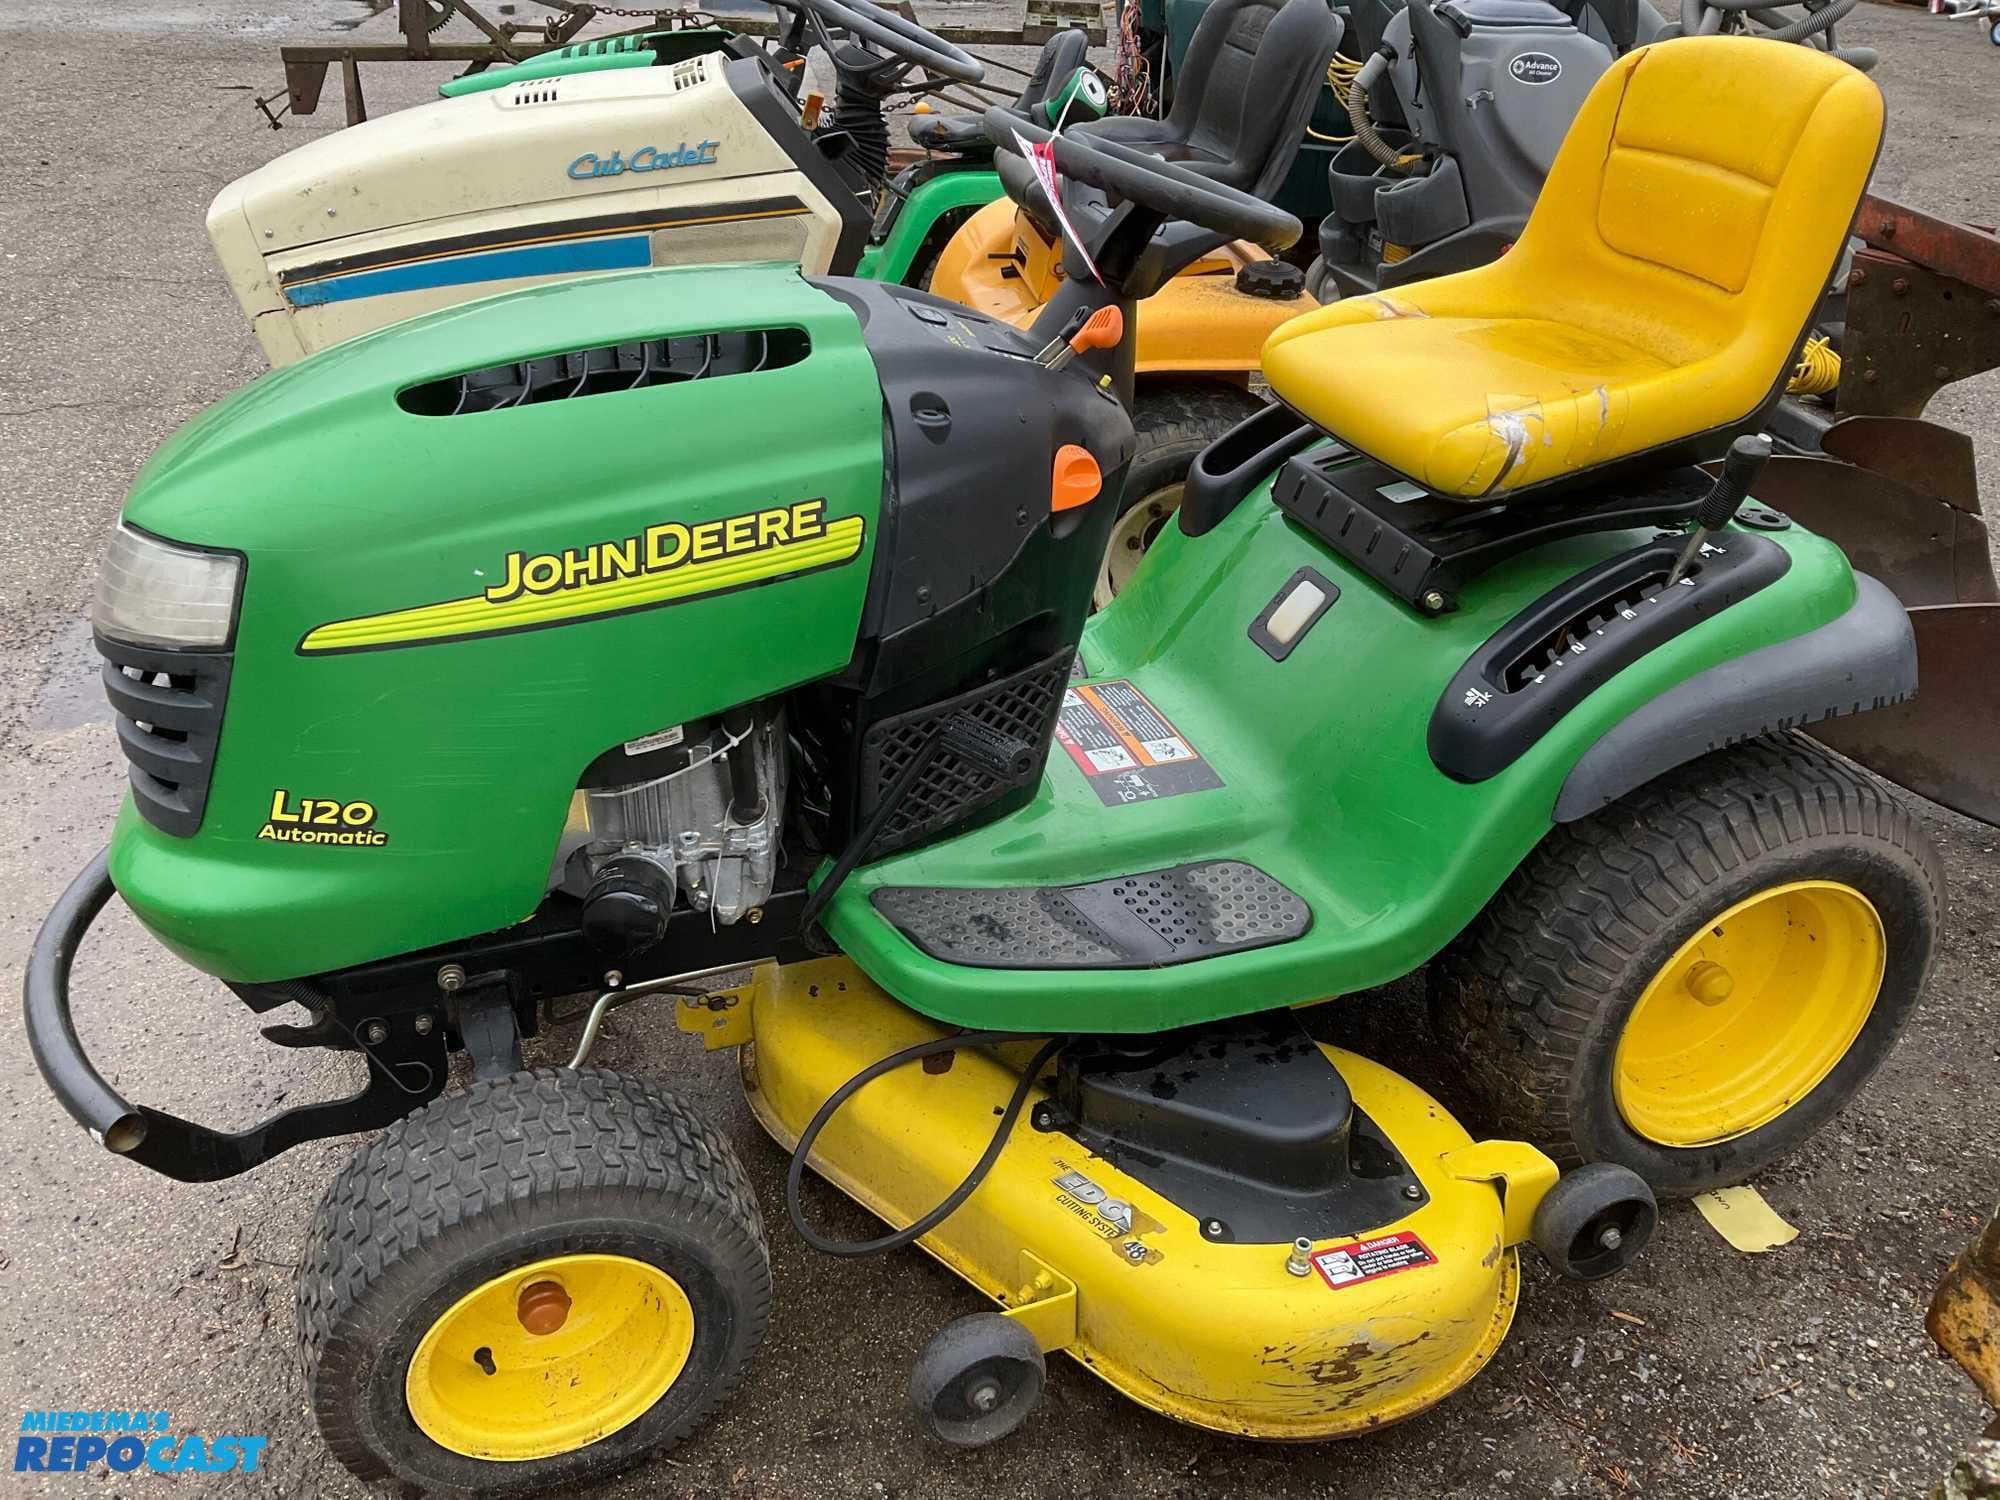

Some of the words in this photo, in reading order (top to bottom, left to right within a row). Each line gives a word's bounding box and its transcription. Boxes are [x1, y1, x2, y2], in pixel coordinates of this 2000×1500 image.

[1525, 61, 1558, 71] Advance
[568, 149, 626, 179] Cub
[628, 139, 721, 173] Cadet
[485, 534, 641, 602] JOHN
[644, 498, 826, 572] DEERE
[1621, 608, 1638, 621] 3
[1570, 641, 1587, 655] 2
[270, 789, 375, 827] L120
[258, 824, 386, 844] Automatic
[1054, 1160, 1071, 1171] THE
[1056, 1194, 1092, 1221] CUTTING
[1124, 1241, 1148, 1259] 48
[1366, 1237, 1400, 1248] DANGER
